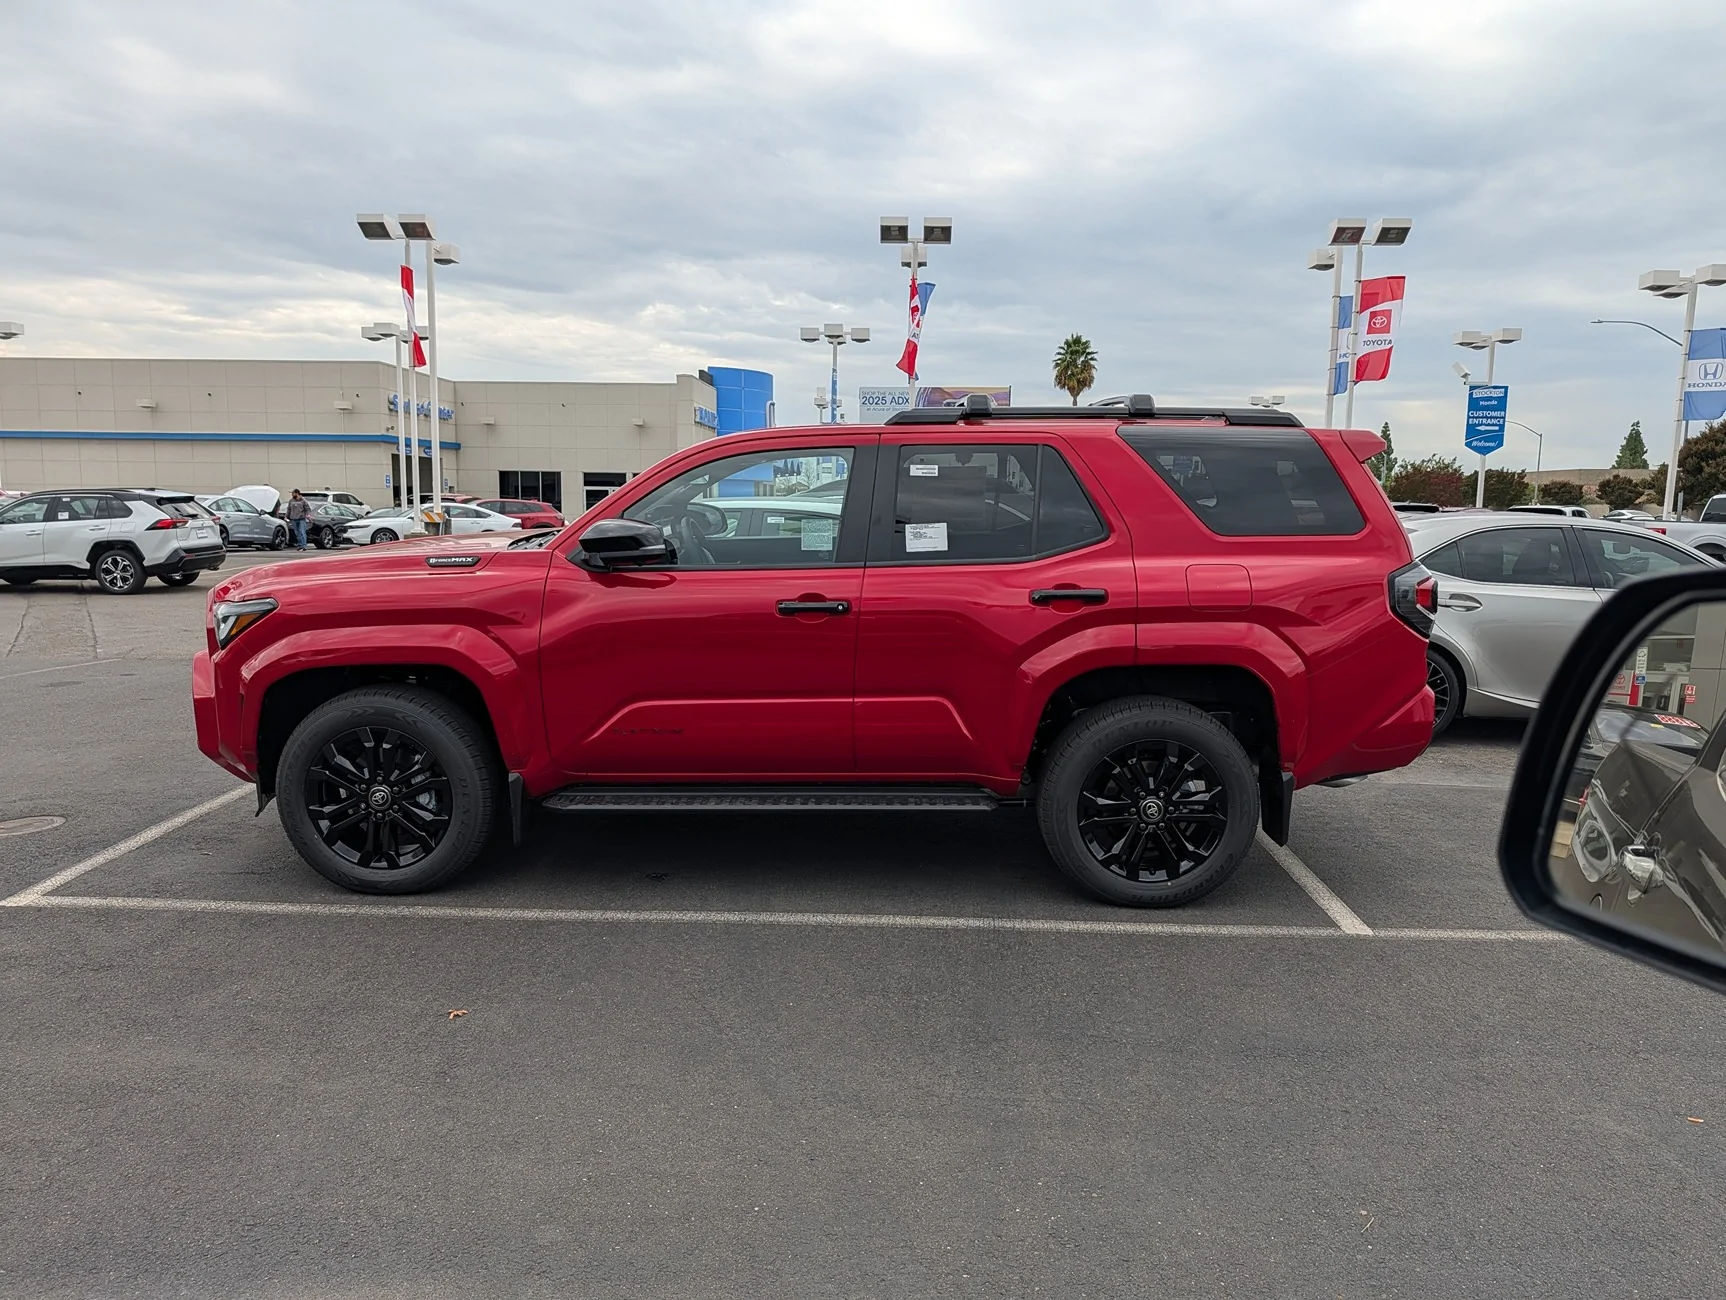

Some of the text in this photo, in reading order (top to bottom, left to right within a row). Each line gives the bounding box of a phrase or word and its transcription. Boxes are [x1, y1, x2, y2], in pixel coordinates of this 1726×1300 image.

[1362, 338, 1392, 347] TOYOTA
[862, 396, 910, 405] 2025 ADX
